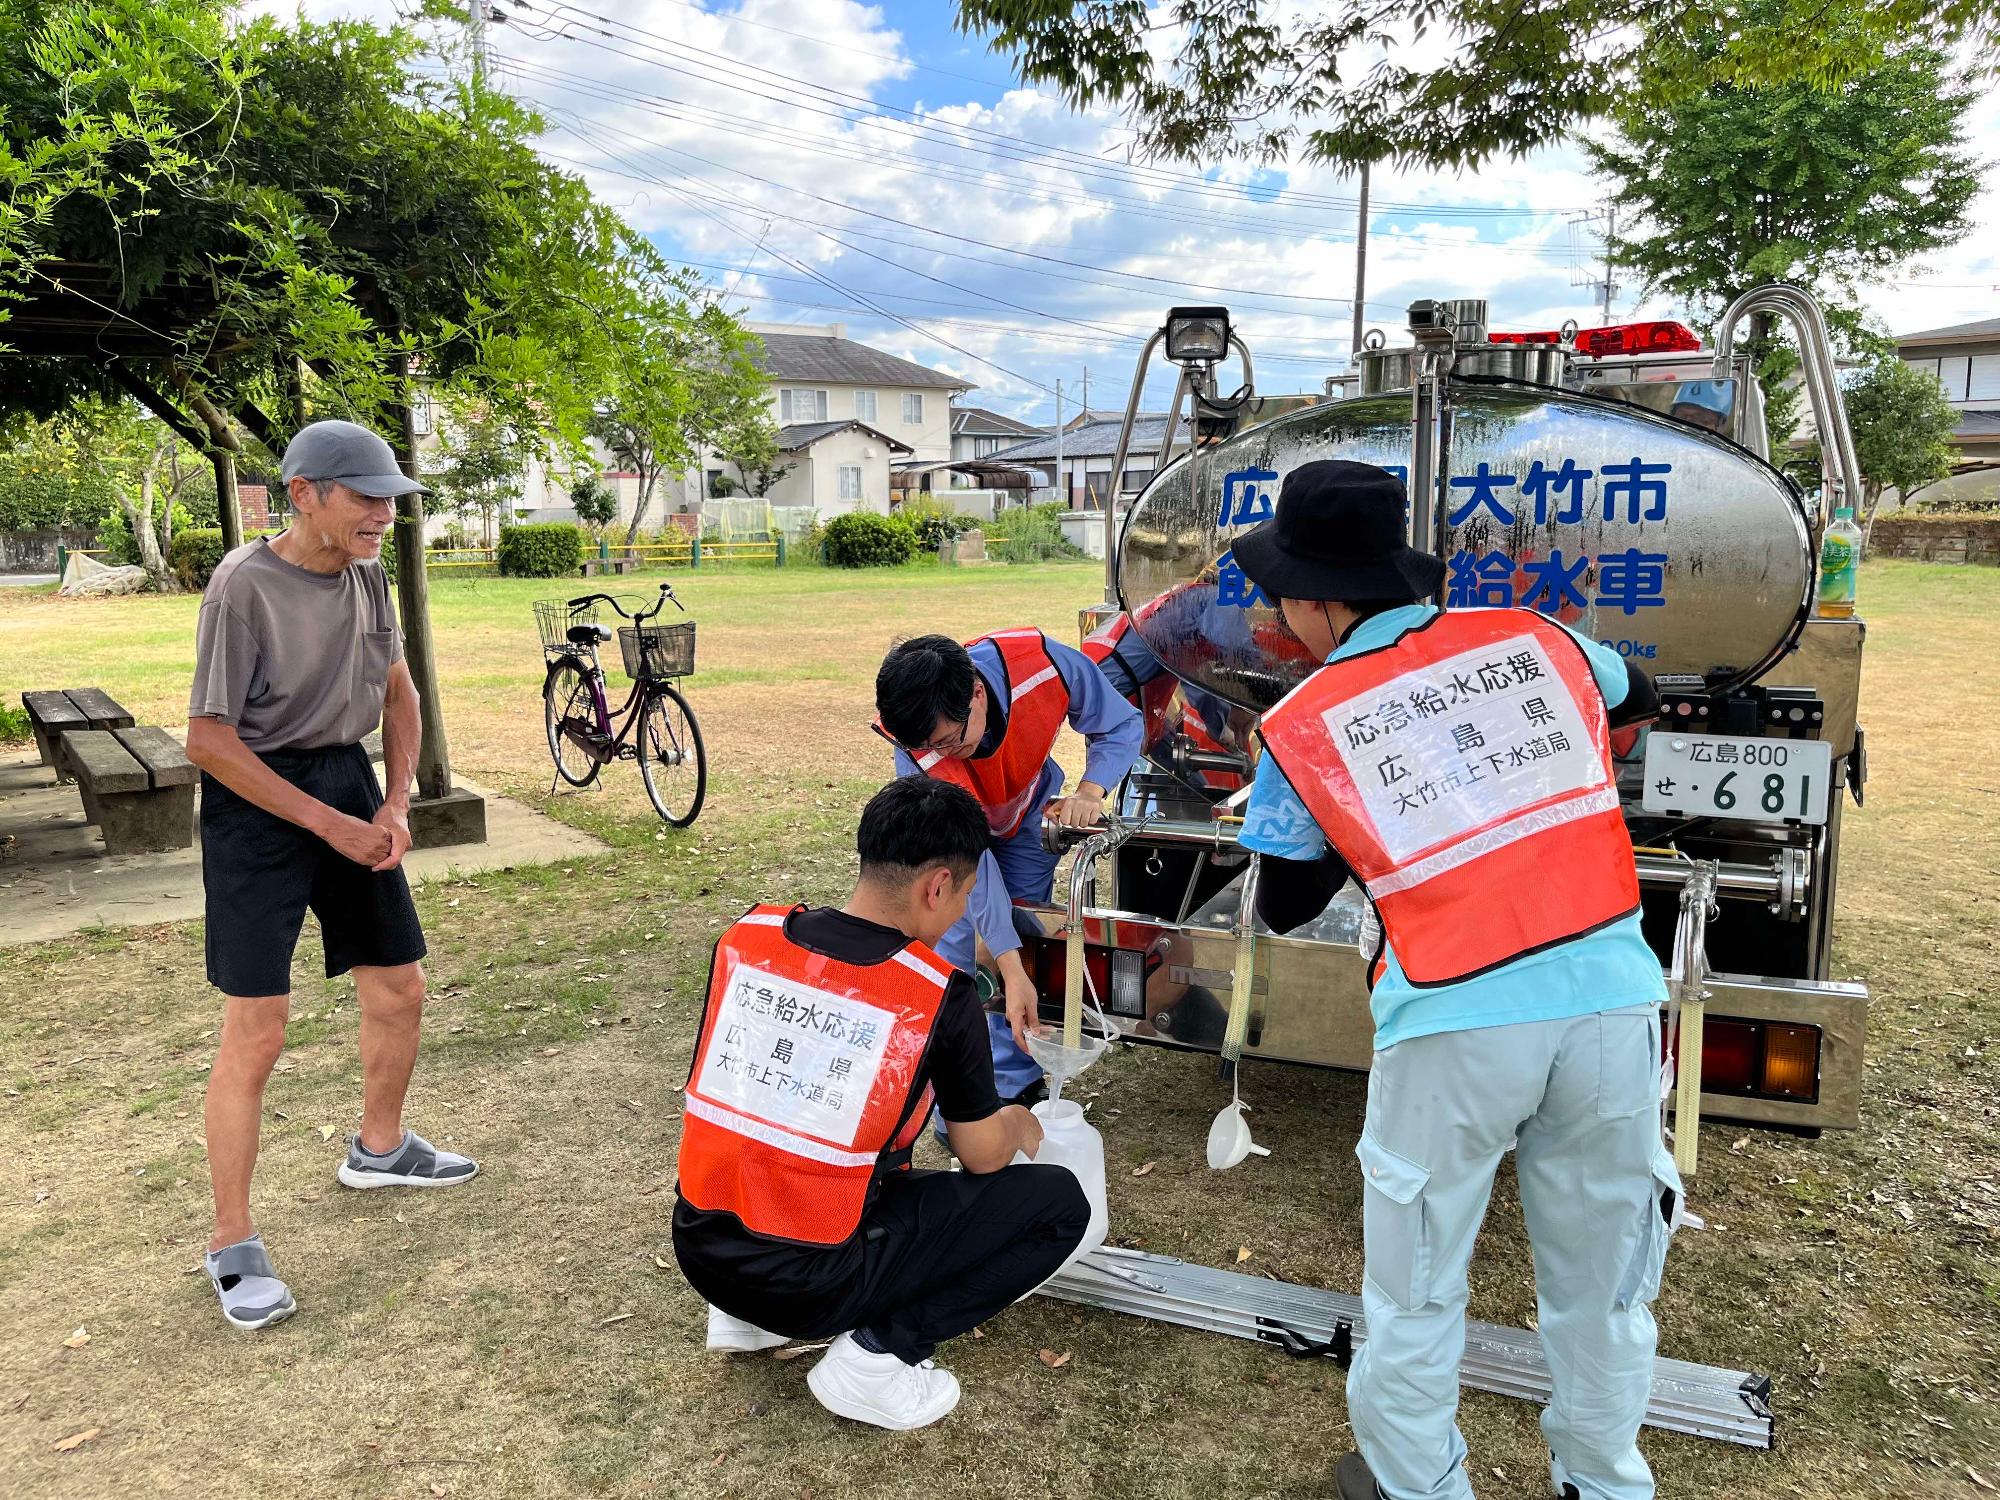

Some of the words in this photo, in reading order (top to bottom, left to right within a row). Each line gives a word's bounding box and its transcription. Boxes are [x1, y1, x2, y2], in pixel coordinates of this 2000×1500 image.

[1218, 457, 1672, 527] 広大竹市
[1344, 651, 1546, 751] 応急給水応援
[1392, 730, 1571, 816] 大竹市上下水道局
[734, 981, 877, 1051] 応急給水応援
[717, 1052, 843, 1111] 大竹市上下水道局
